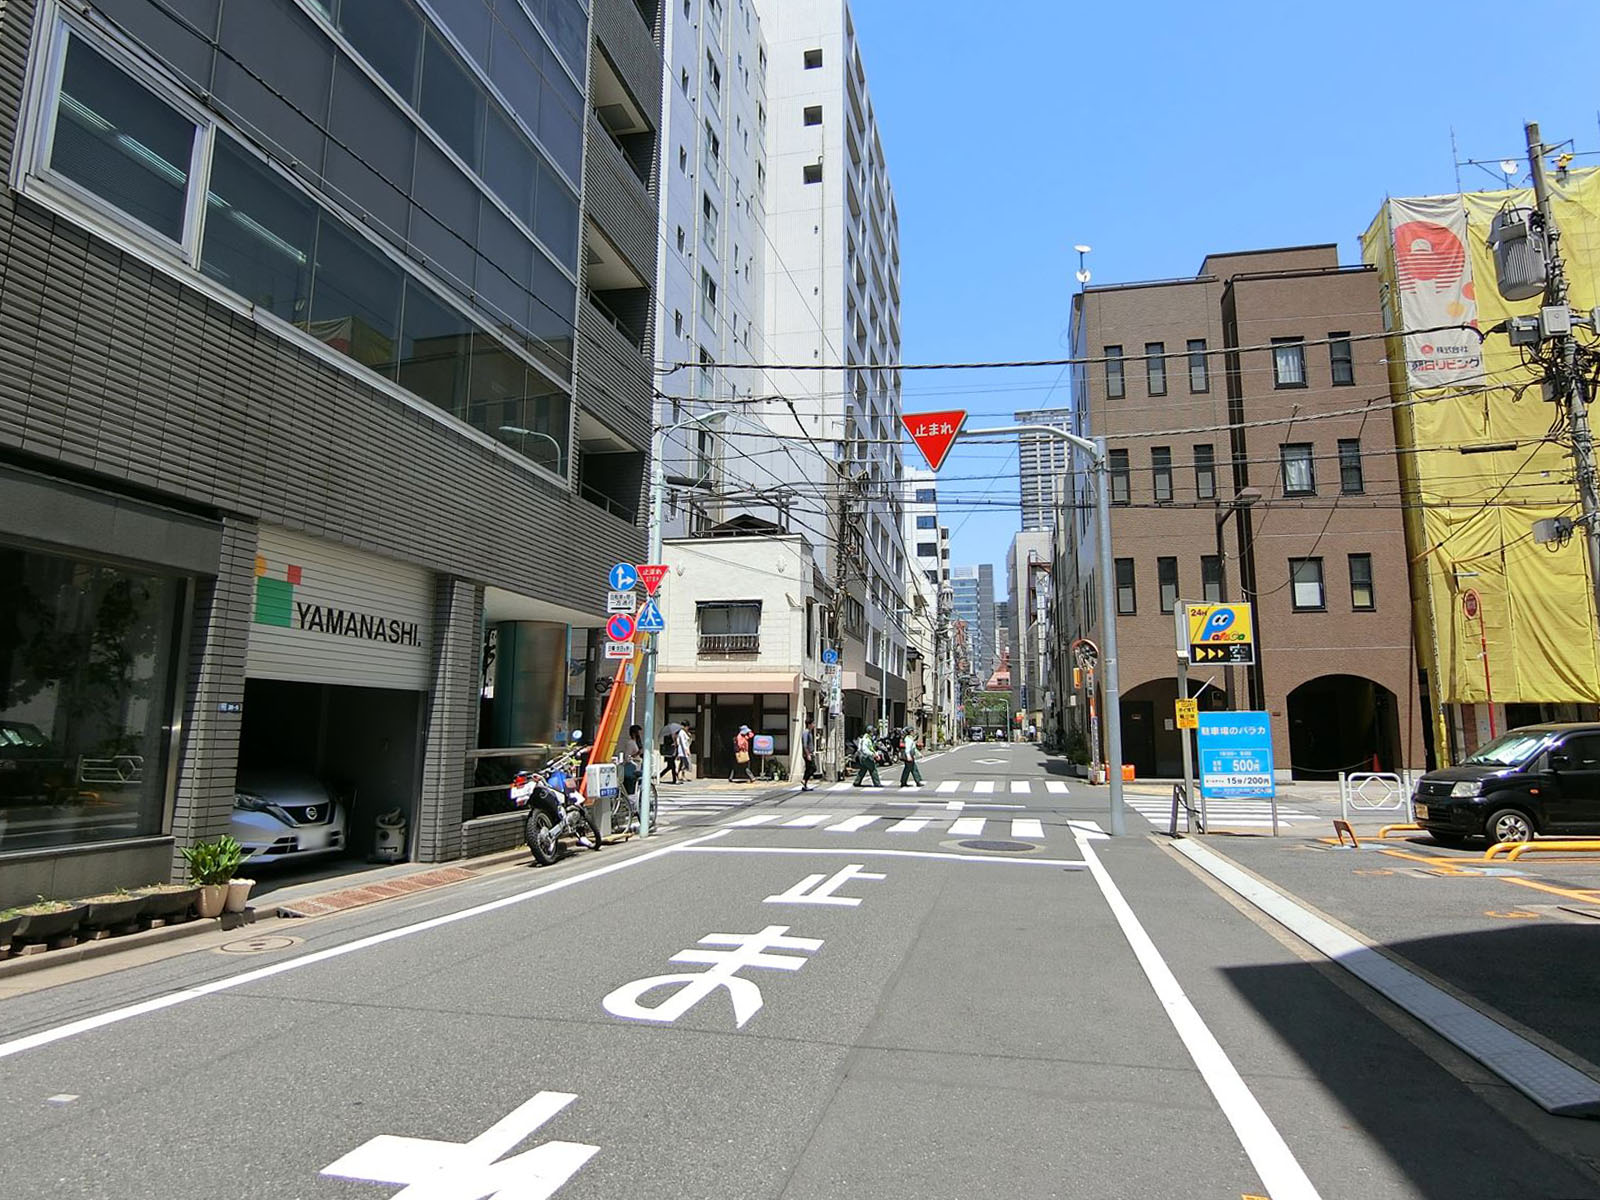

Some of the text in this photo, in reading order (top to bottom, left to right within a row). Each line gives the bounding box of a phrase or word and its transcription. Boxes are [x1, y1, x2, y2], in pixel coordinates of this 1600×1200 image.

[914, 422, 954, 438] 止まれ
[296, 602, 422, 647] YAMANASHI.
